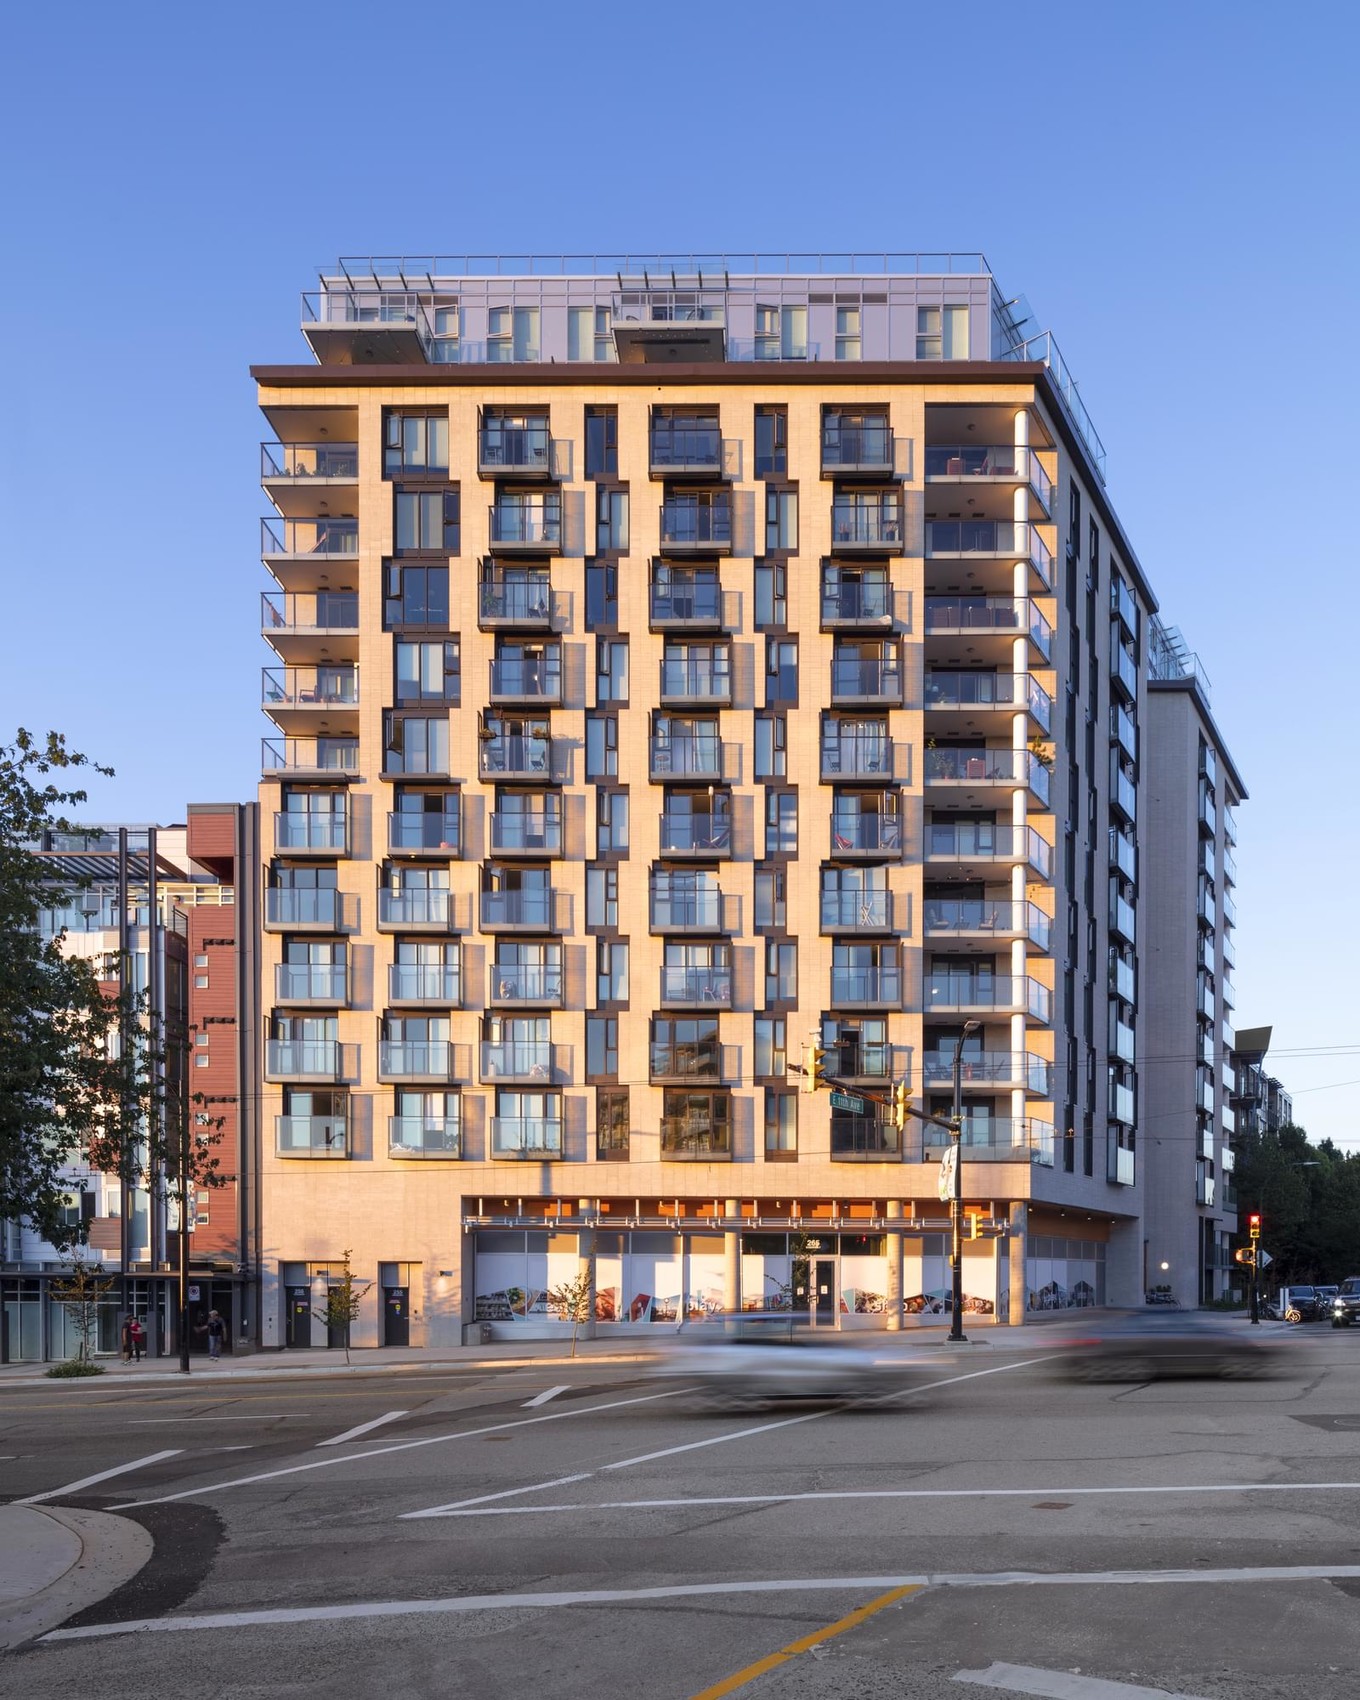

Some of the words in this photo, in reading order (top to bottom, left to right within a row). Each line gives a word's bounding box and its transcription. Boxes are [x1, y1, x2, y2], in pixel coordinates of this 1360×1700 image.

[838, 1096, 849, 1107] 11th
[850, 1099, 861, 1111] Ave
[806, 1239, 821, 1247] 265
